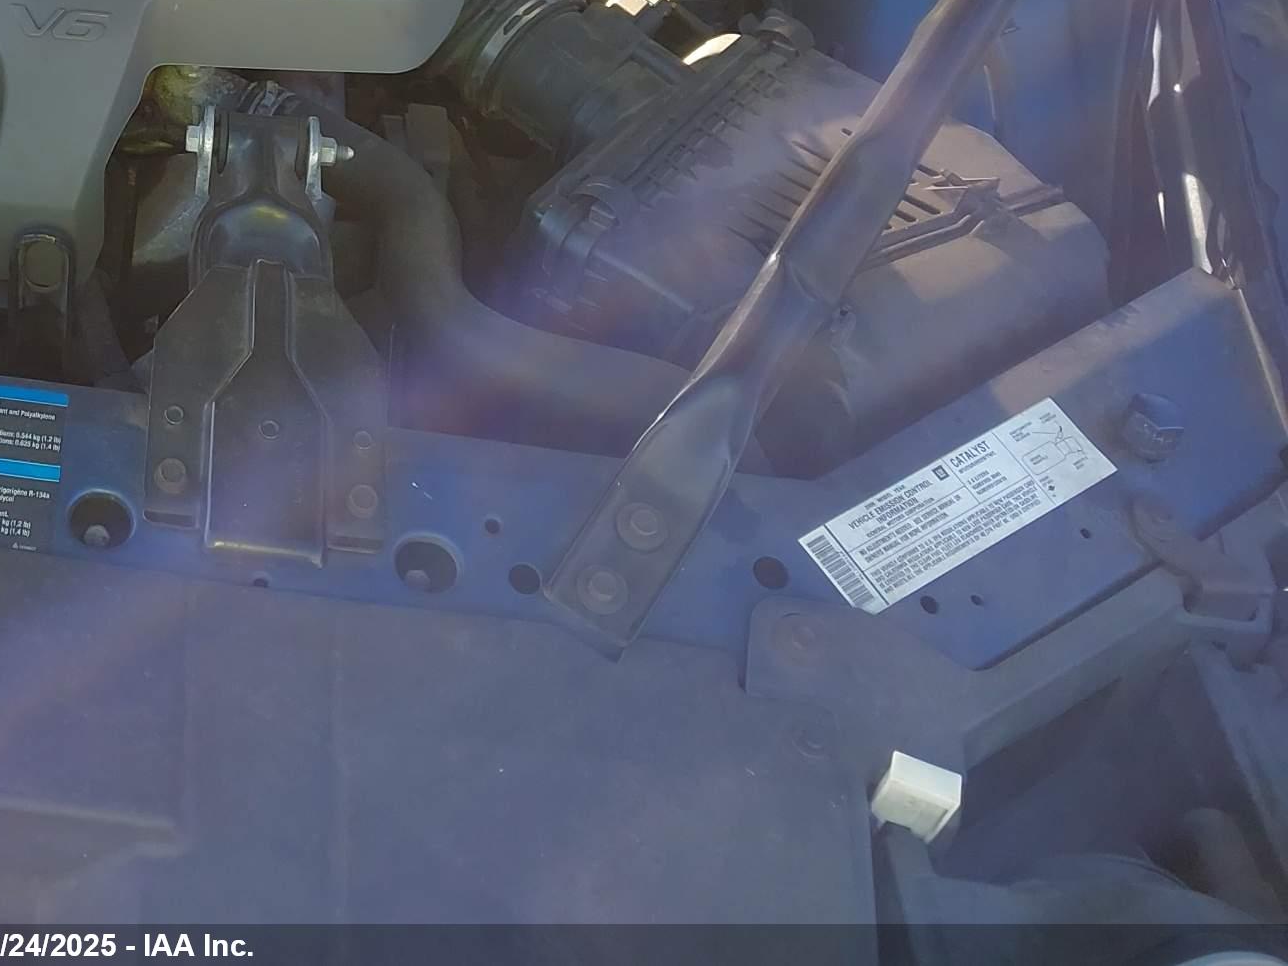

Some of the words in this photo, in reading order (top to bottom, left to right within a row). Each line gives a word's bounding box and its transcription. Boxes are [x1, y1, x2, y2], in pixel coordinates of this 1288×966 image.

[11, 3, 111, 41] V6
[948, 439, 992, 468] CATALYST
[847, 510, 876, 529] VEHICLE
[872, 494, 905, 515] EMISSION
[902, 478, 933, 498] CONTROL
[875, 496, 919, 524] INFORMATION
